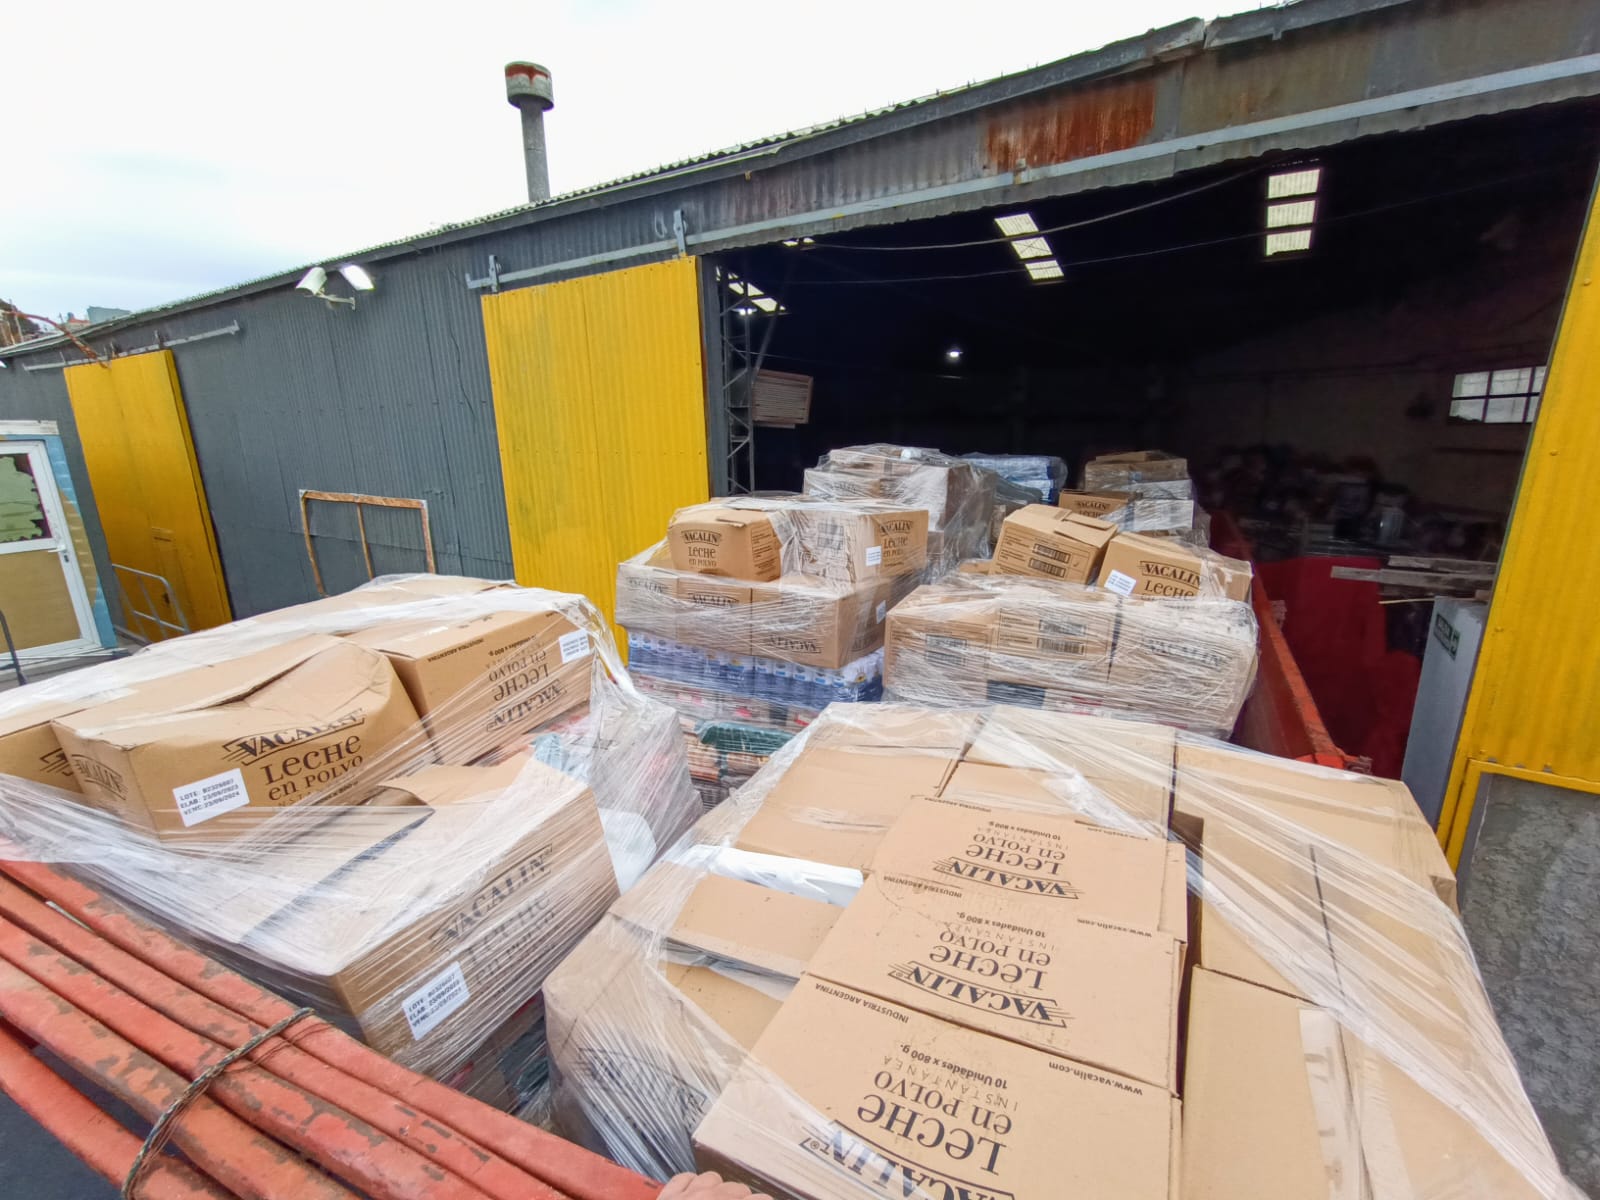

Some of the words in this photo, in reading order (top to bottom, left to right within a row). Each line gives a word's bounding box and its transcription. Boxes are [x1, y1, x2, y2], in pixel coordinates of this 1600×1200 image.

[268, 780, 298, 802] en
[304, 755, 364, 790] POLVO
[972, 832, 1028, 853] POLVO
[1038, 846, 1066, 862] en
[883, 875, 923, 890] ARGENTINA
[949, 859, 1067, 896] VACALIN
[923, 881, 963, 899] INDUSTRIA
[966, 914, 983, 926] 800
[990, 920, 1034, 937] Unidades
[939, 929, 1009, 958] POLVO
[1034, 930, 1046, 939] 10
[1018, 947, 1052, 967] en
[814, 982, 862, 1006] ARGENTINA
[910, 965, 1054, 1022] VACALIN
[862, 998, 910, 1025] INDUSTRIA
[910, 1048, 931, 1065] 800
[882, 1054, 1019, 1111] INSTANTANEA
[940, 1061, 994, 1087] Unidades
[994, 1077, 1009, 1089] 10
[1048, 1060, 1144, 1096] www.vacalin.com
[873, 1069, 959, 1119] POLVO
[970, 1107, 1013, 1136] en
